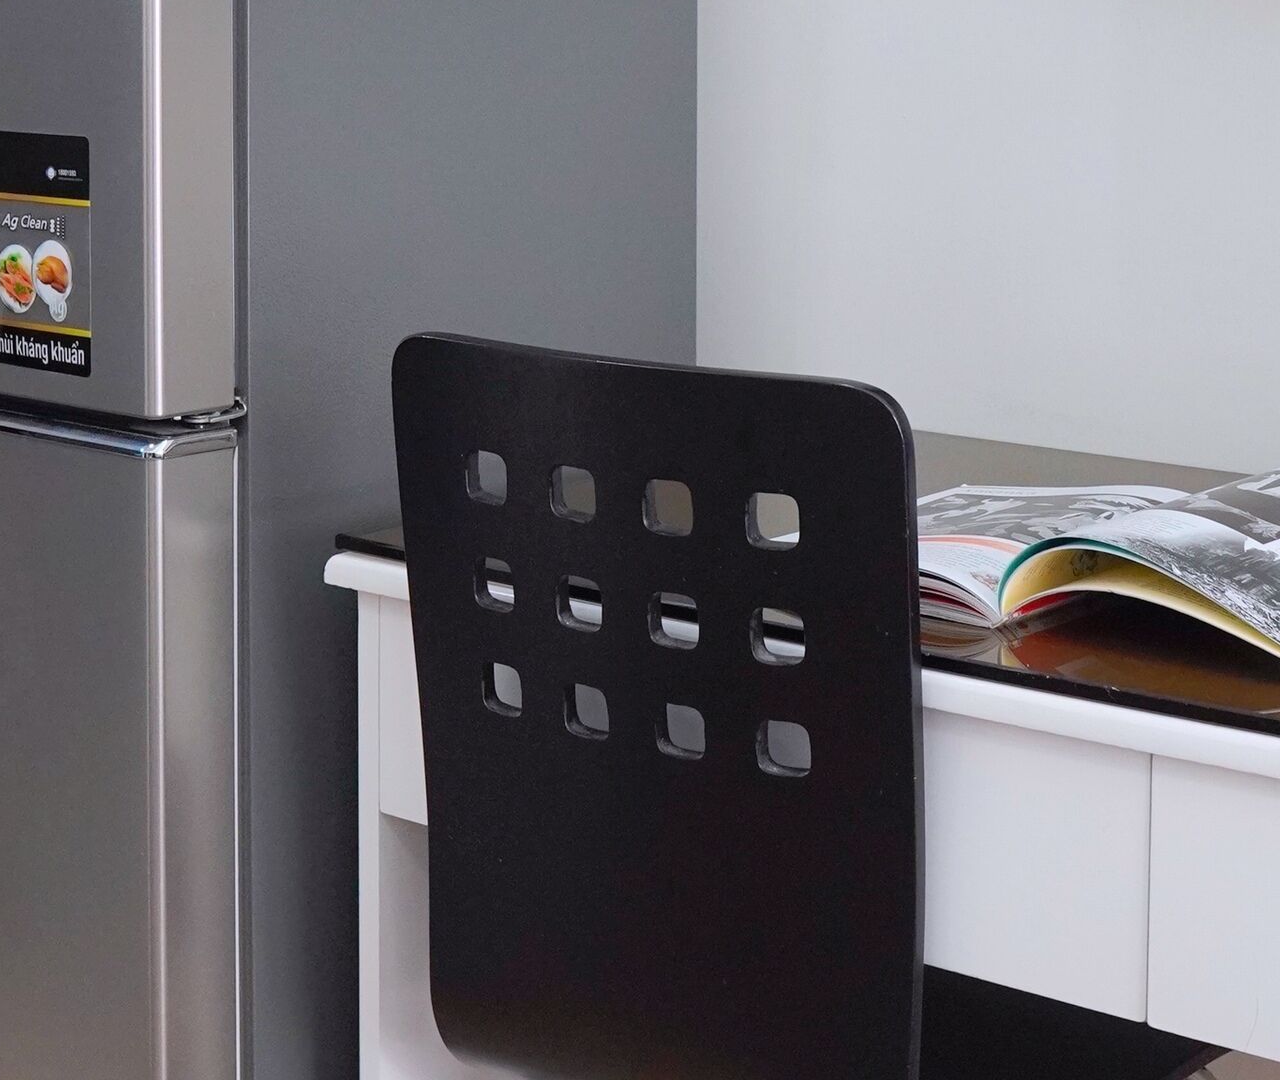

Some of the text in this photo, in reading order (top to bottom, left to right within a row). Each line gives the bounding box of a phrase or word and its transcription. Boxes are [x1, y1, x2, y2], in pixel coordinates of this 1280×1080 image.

[2, 213, 48, 231] Ag Clean
[15, 335, 48, 365] kháng
[51, 340, 85, 366] khuẩn
